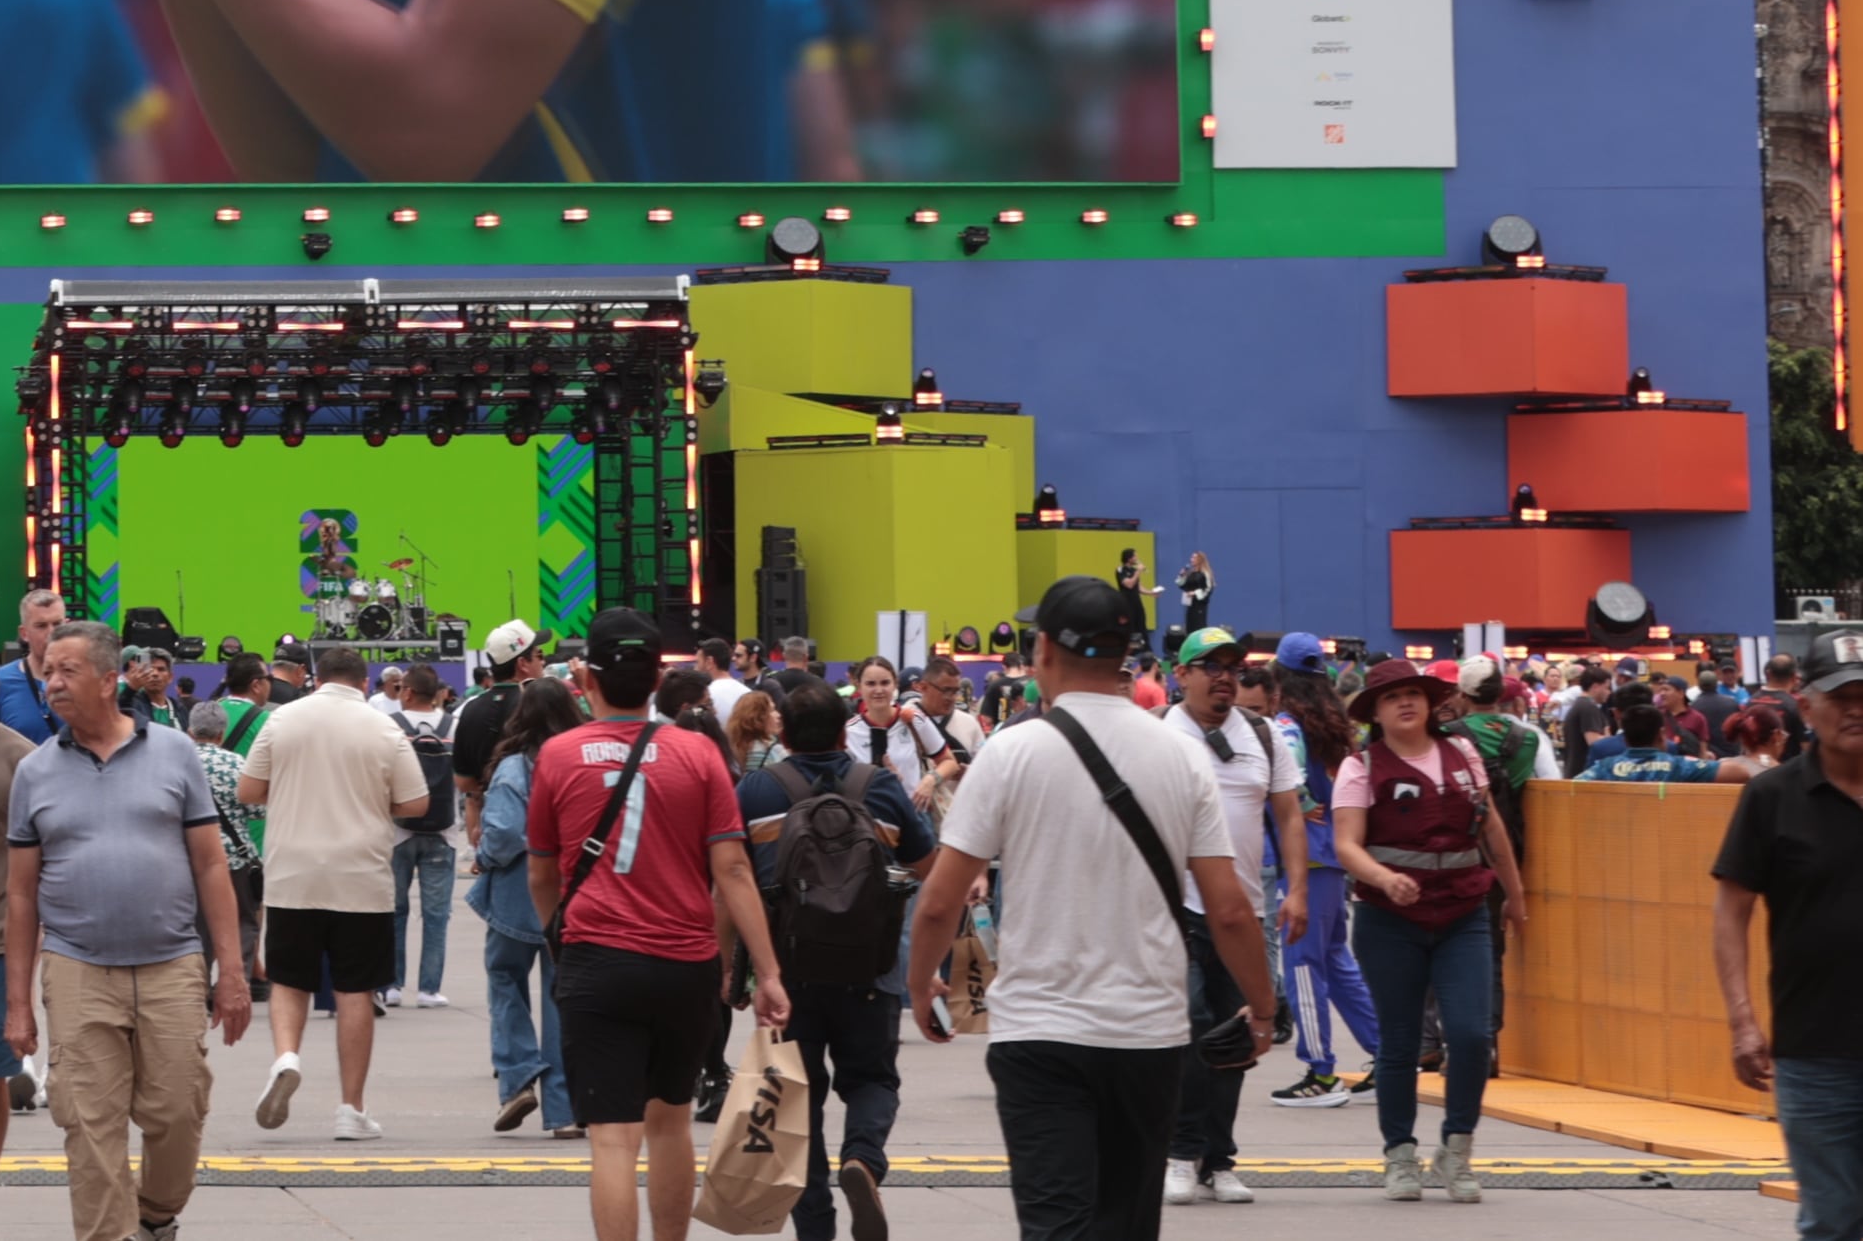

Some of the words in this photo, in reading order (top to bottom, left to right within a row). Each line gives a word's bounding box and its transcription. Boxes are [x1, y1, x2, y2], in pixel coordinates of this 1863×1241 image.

[602, 770, 646, 874] 7
[967, 959, 988, 1016] VISA
[741, 1066, 784, 1153] VISA
